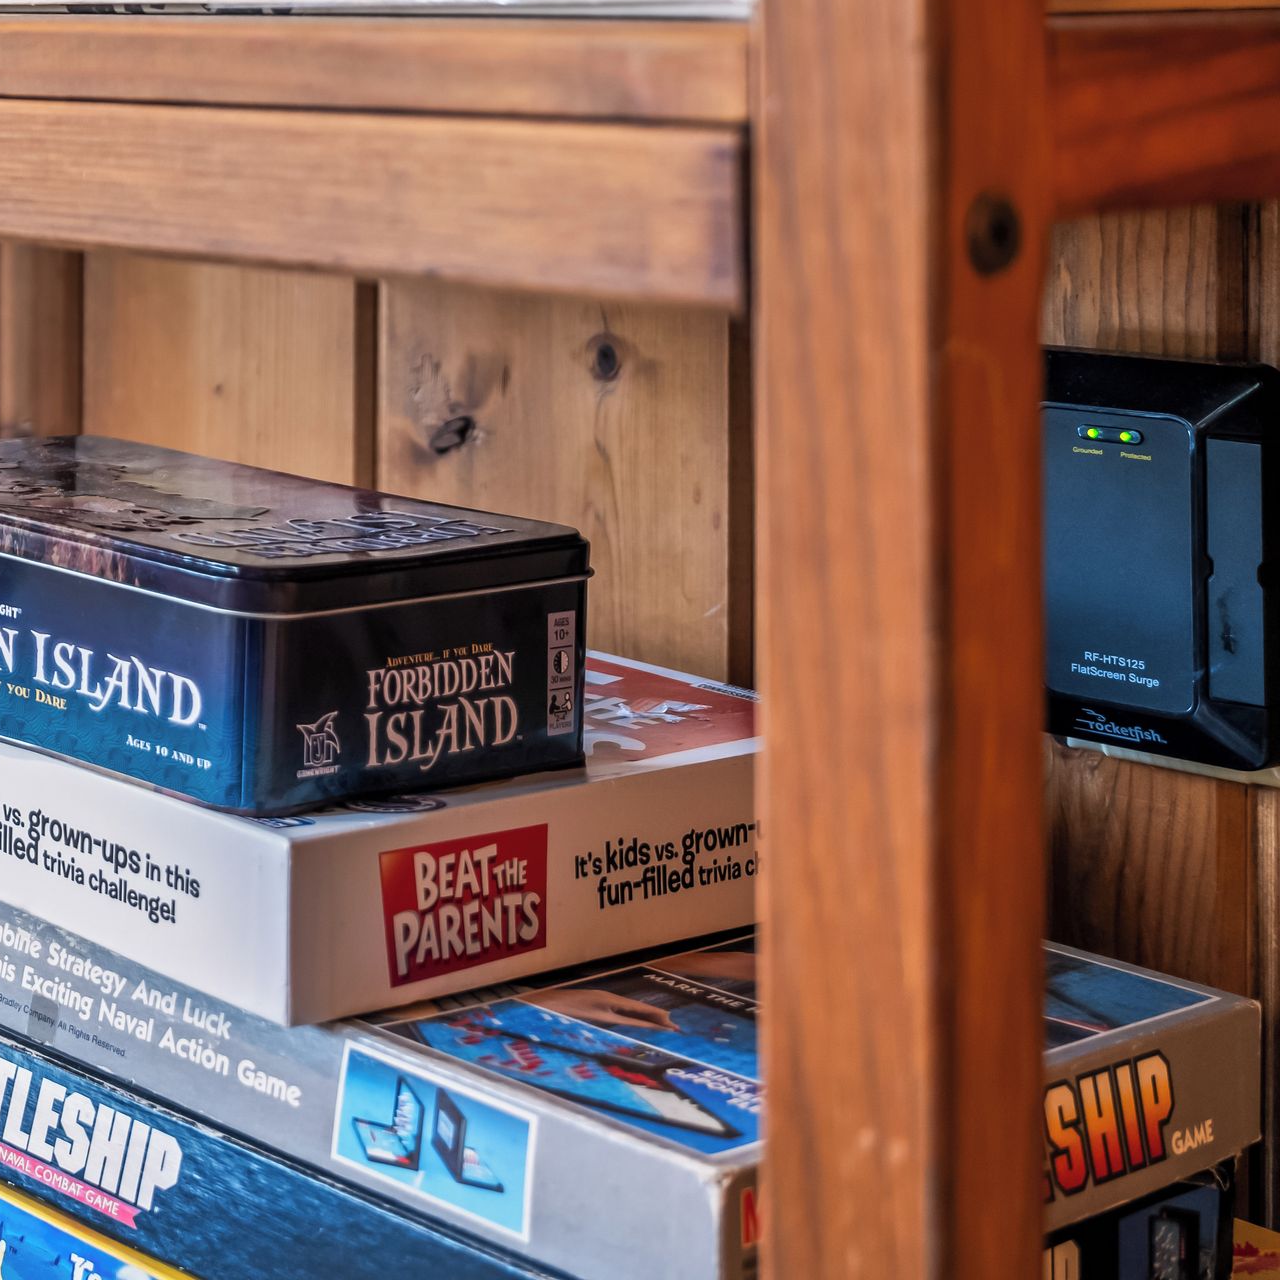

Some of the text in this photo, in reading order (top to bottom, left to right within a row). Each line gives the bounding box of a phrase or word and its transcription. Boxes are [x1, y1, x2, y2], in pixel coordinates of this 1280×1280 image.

[554, 628, 569, 640] 10+
[30, 629, 201, 726] ISLAND
[365, 650, 516, 709] FORBIDDEN
[1071, 663, 1160, 688] FlatScreen Surge
[1084, 651, 1146, 670] RF-HTS125
[155, 745, 169, 757] 10
[364, 695, 519, 770] ISLAND
[1087, 721, 1164, 742] rocketfish
[3, 803, 25, 828] vs.
[28, 808, 141, 874] grown-ups
[145, 852, 161, 881] in
[165, 864, 200, 898] this
[575, 851, 602, 880] It's
[605, 837, 651, 873] kids
[654, 842, 679, 862] vs.
[42, 849, 84, 885] trivia
[89, 869, 177, 924] challenge!
[413, 843, 528, 911] BEAT THE
[597, 864, 694, 909] fun-filled
[698, 856, 742, 886] trivia
[393, 891, 541, 977] PARENTS
[47, 942, 127, 998] Strategy
[131, 979, 178, 1016] And
[183, 997, 232, 1040] Luck
[643, 973, 744, 1008] MARK THE
[21, 965, 95, 1021] Exciting
[98, 998, 154, 1042] Naval
[158, 1026, 230, 1076] Action
[237, 1059, 303, 1108] Game
[68, 1023, 90, 1042] Rights
[1171, 1119, 1214, 1156] GAME
[34, 1166, 85, 1197] COMBAT
[85, 1189, 119, 1216] GAME
